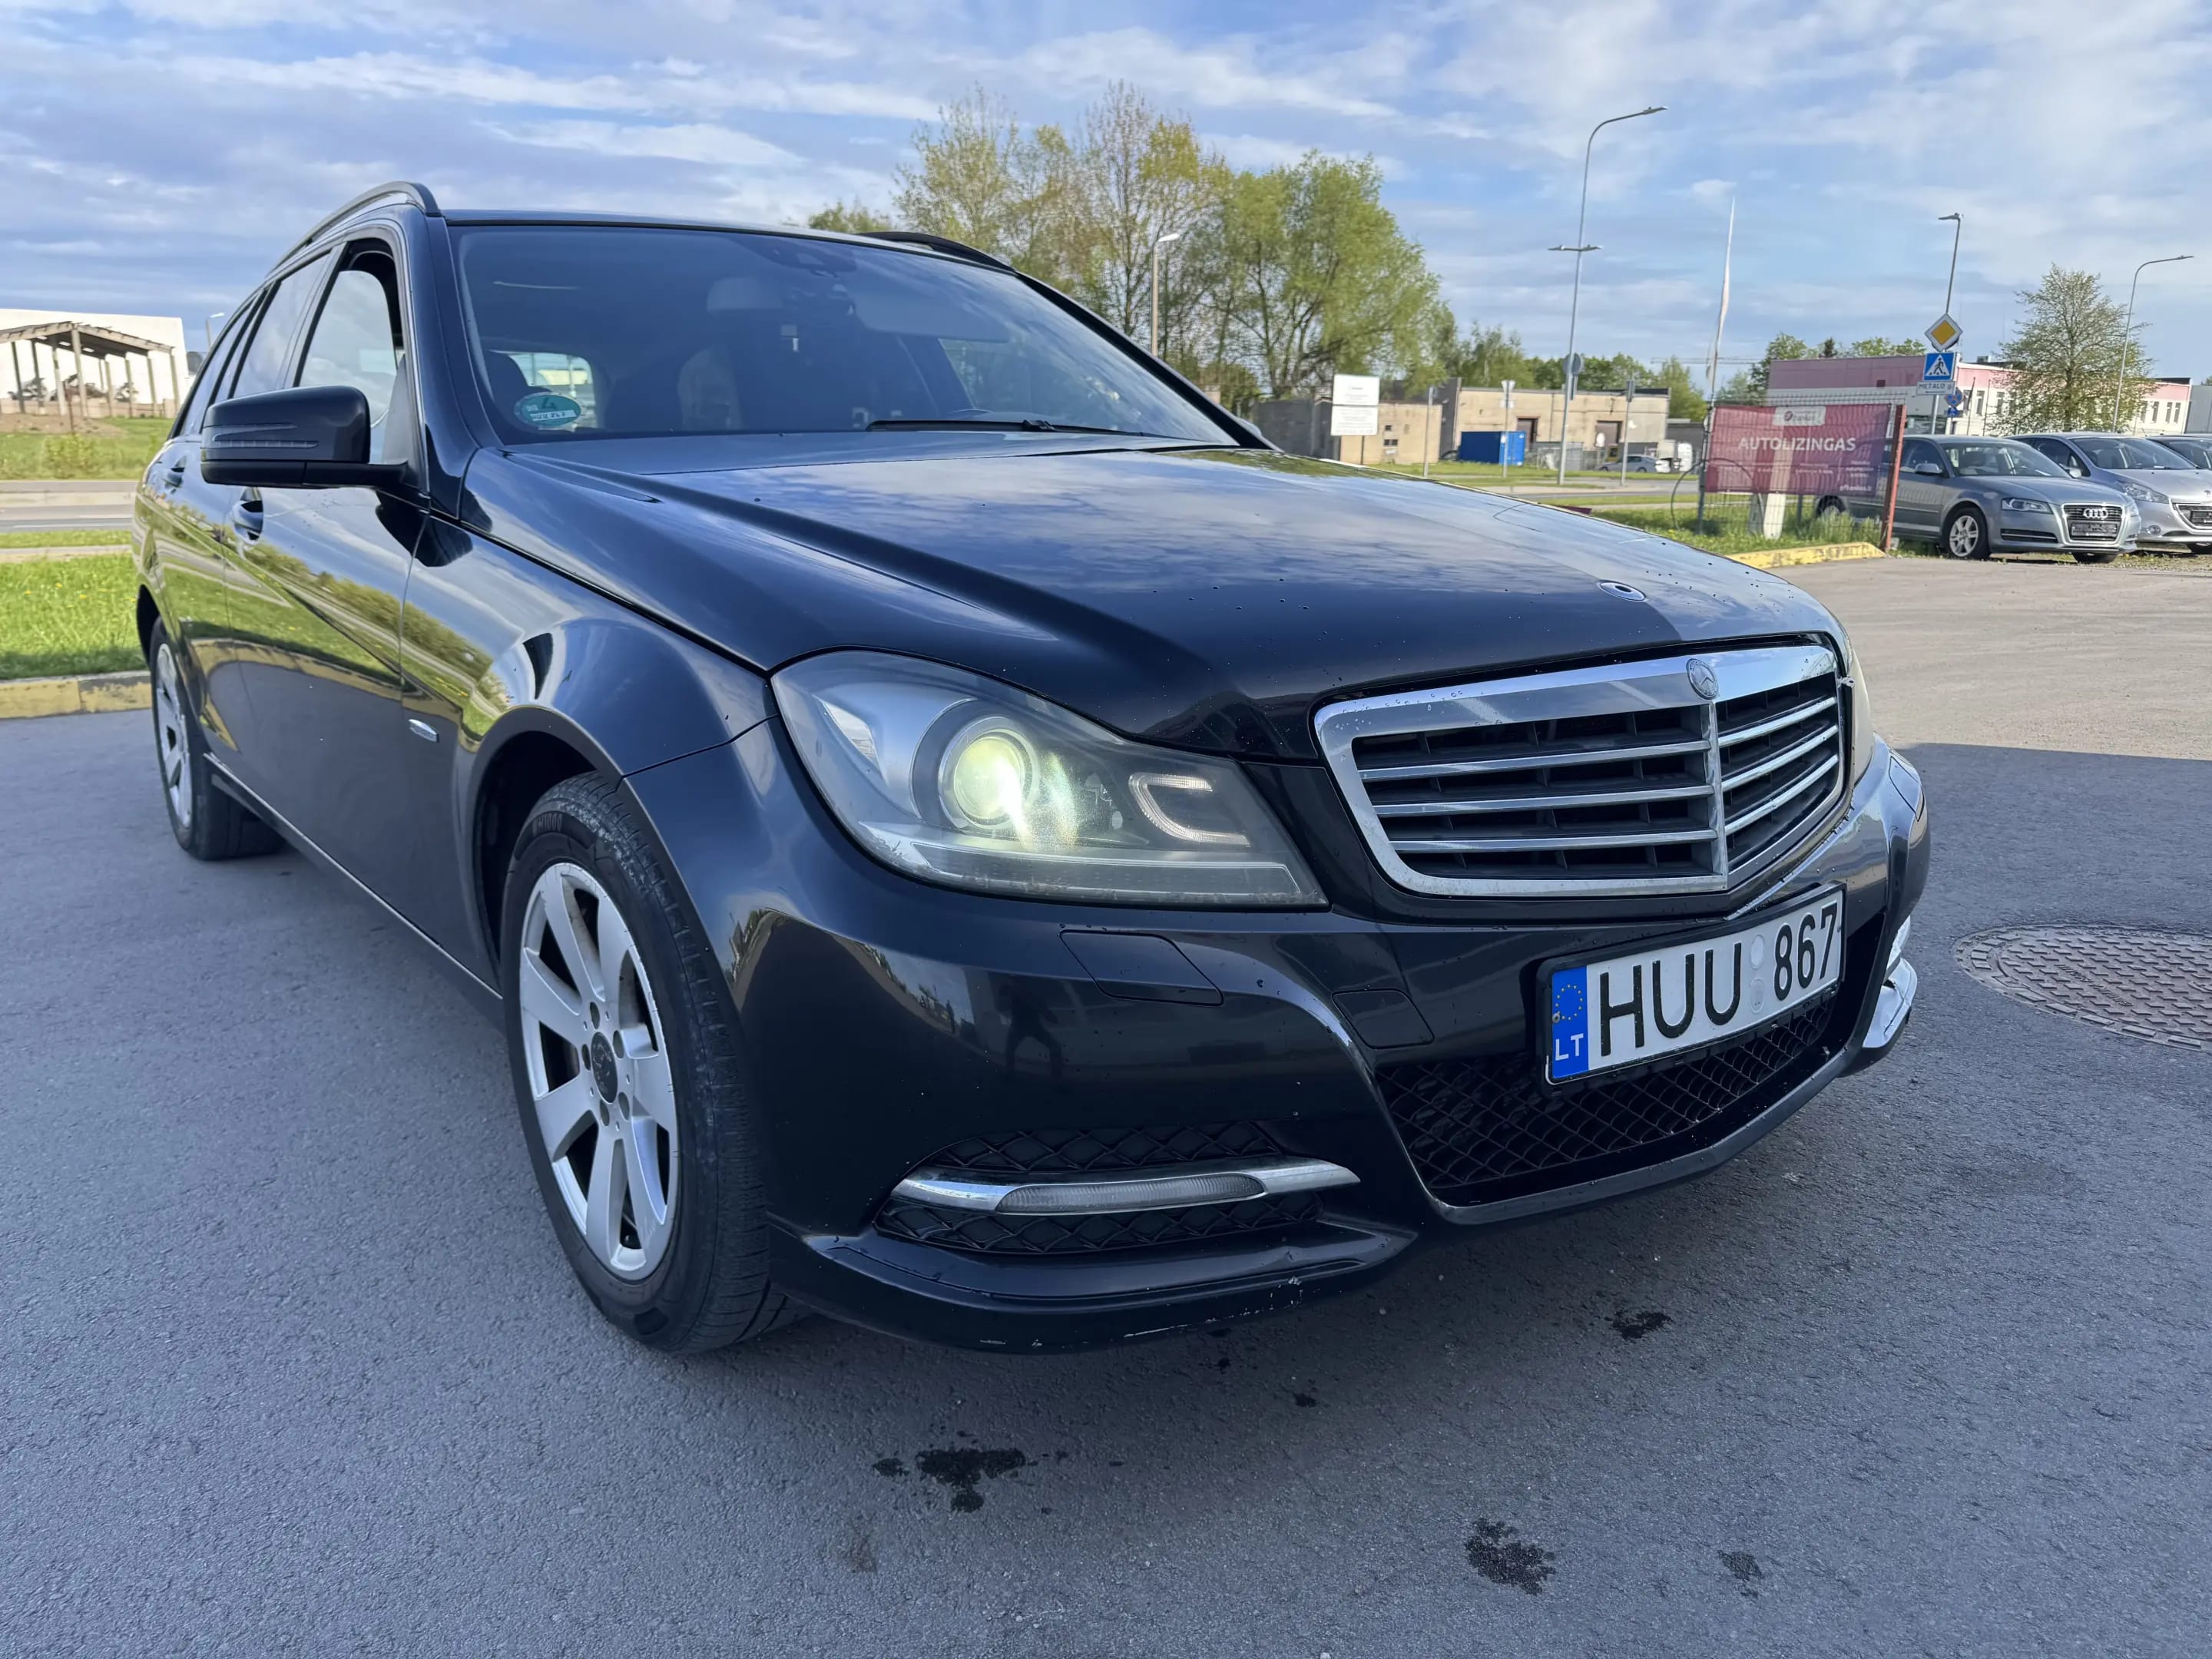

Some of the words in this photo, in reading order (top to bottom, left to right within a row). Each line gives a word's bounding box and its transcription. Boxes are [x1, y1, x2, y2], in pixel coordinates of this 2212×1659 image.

[1737, 436, 1856, 452] AUTOLIZINGAS
[1598, 941, 1742, 1057] HUU
[1773, 900, 1838, 1001] 867
[1555, 1033, 1584, 1061] LT
